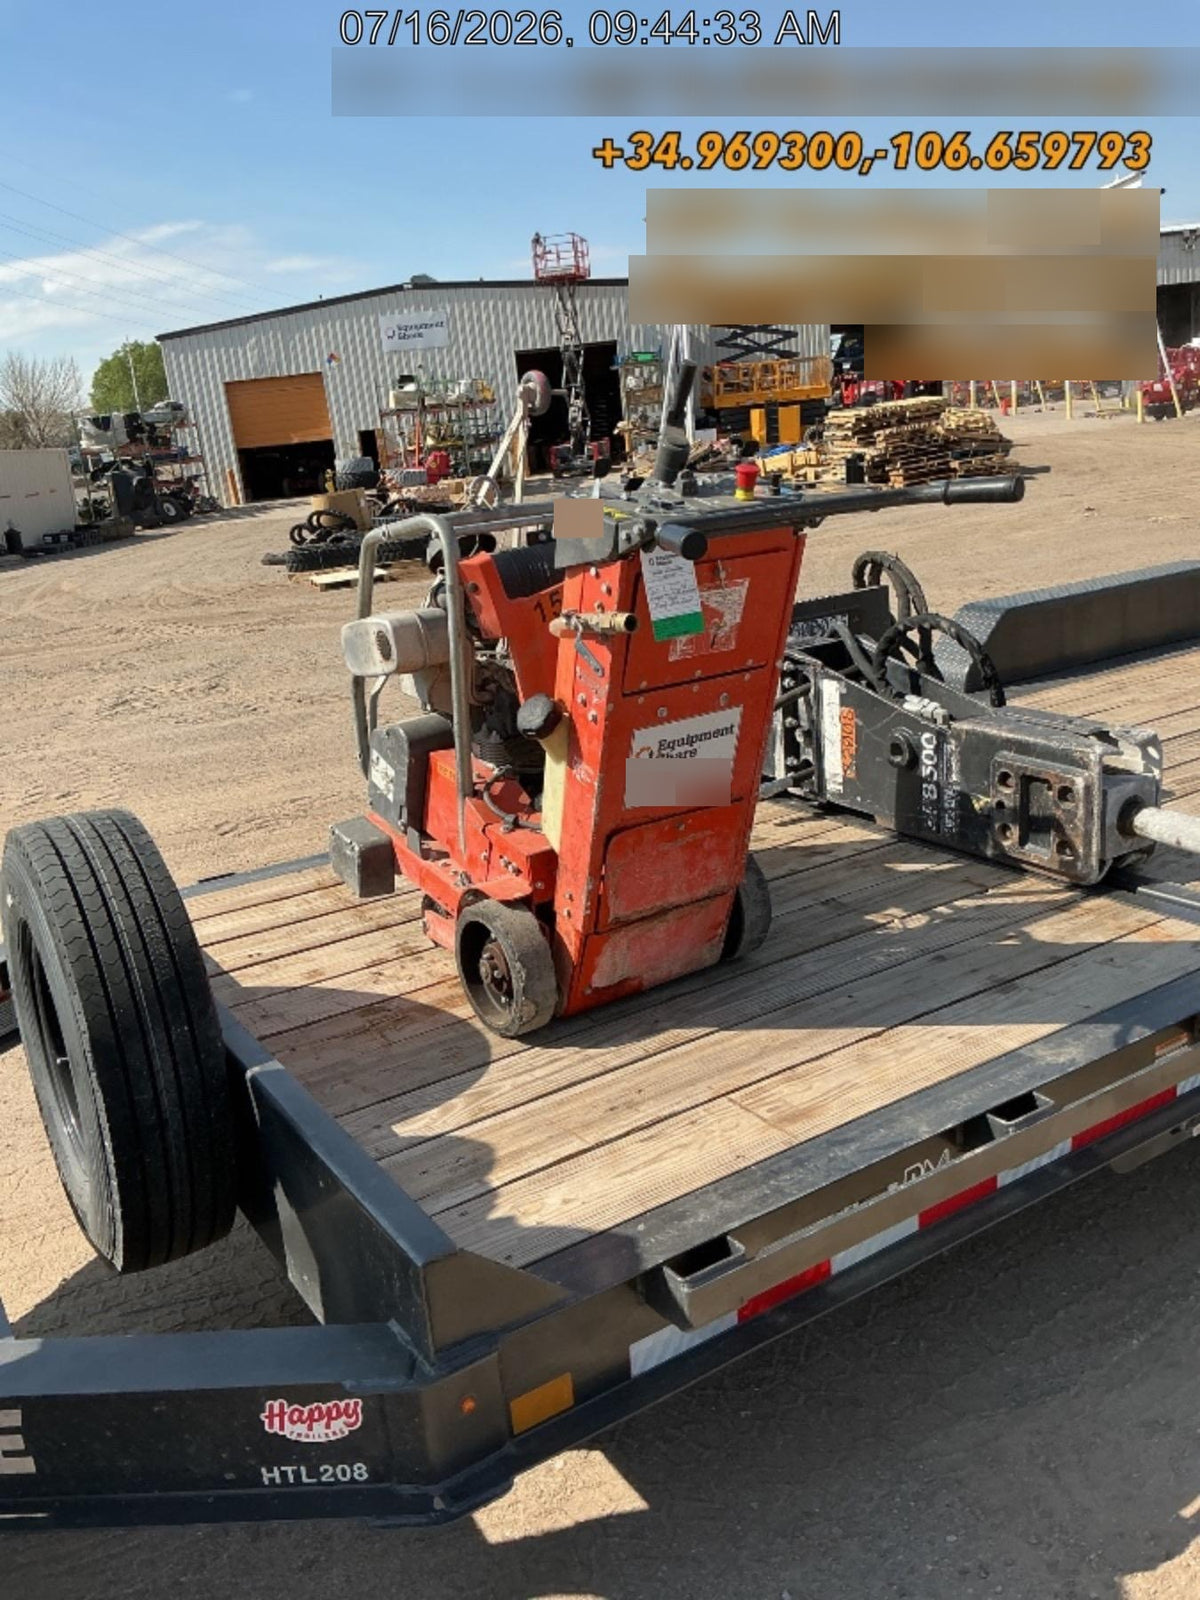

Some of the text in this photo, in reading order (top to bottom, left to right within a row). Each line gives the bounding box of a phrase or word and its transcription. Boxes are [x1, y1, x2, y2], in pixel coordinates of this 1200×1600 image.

[658, 723, 735, 752] Equipment
[262, 1399, 362, 1433] Happy
[261, 1463, 369, 1485] HTL208
